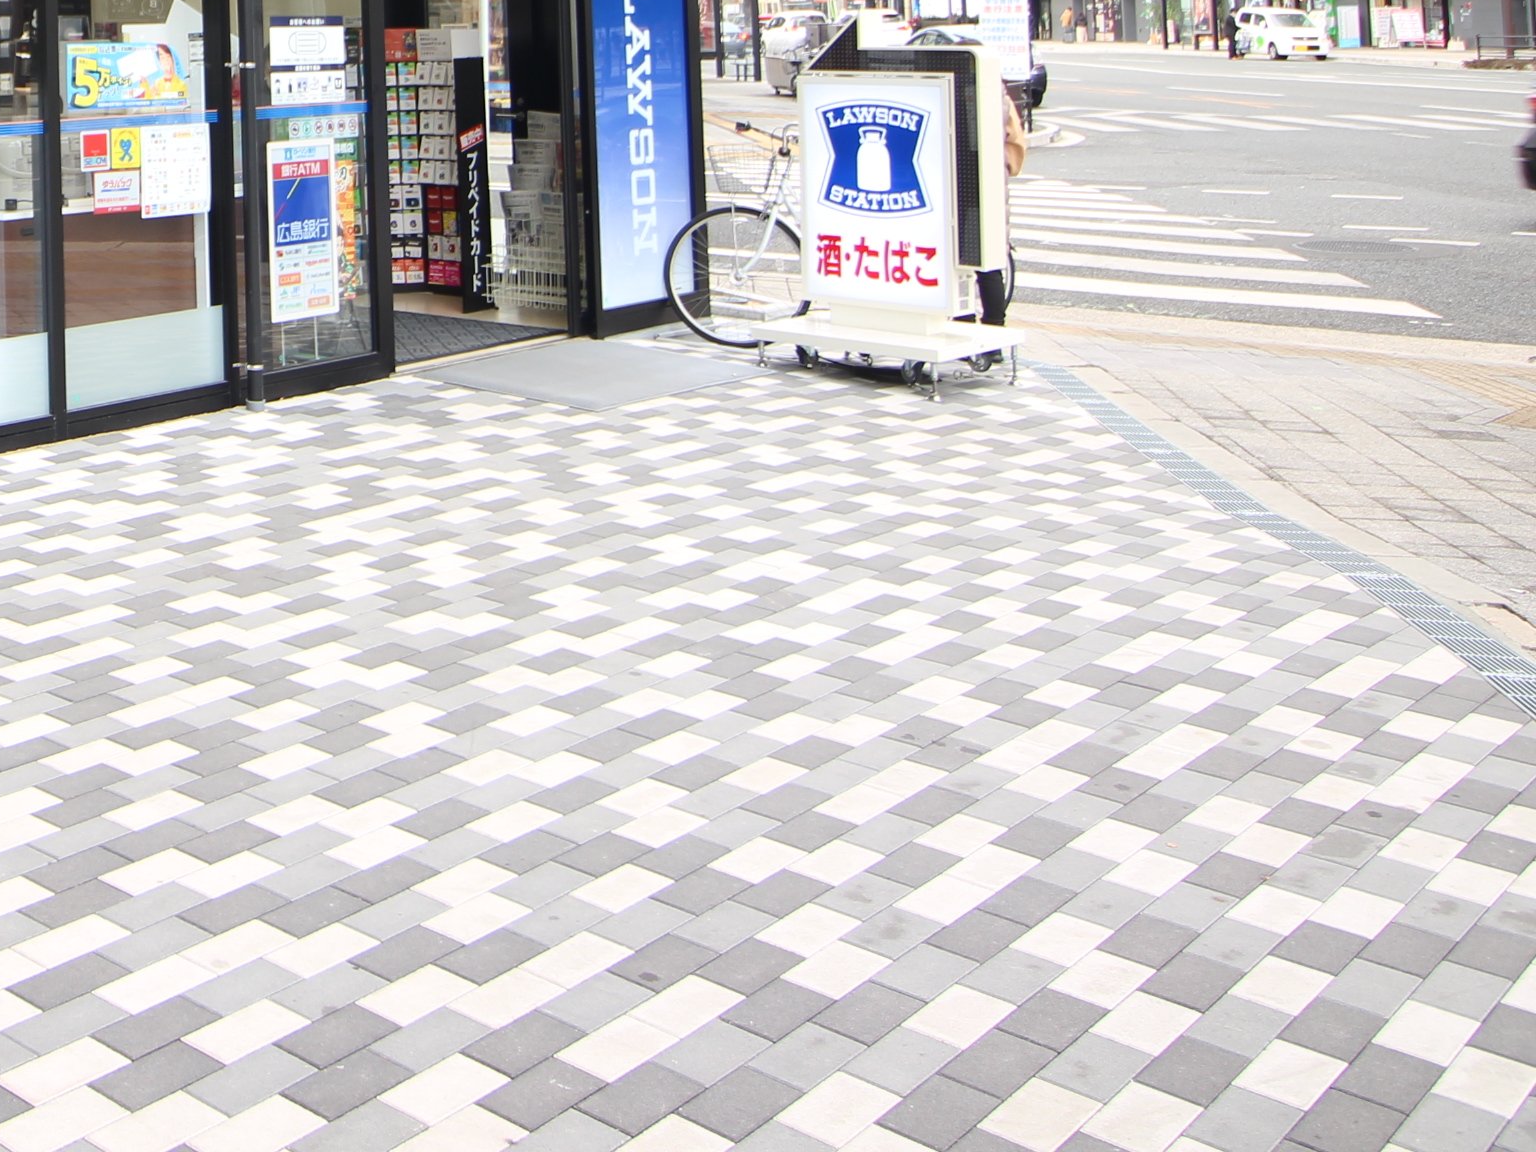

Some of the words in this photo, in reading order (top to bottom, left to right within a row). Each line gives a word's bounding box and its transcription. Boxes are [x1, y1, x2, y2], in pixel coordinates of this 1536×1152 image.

[825, 105, 920, 133] LAWSON
[281, 162, 321, 177] 銀行ATM
[828, 185, 920, 211] STATION
[276, 218, 329, 244] 広島銀行
[466, 151, 482, 293] プリペイドカード
[816, 233, 939, 287] 酒・たばこ
